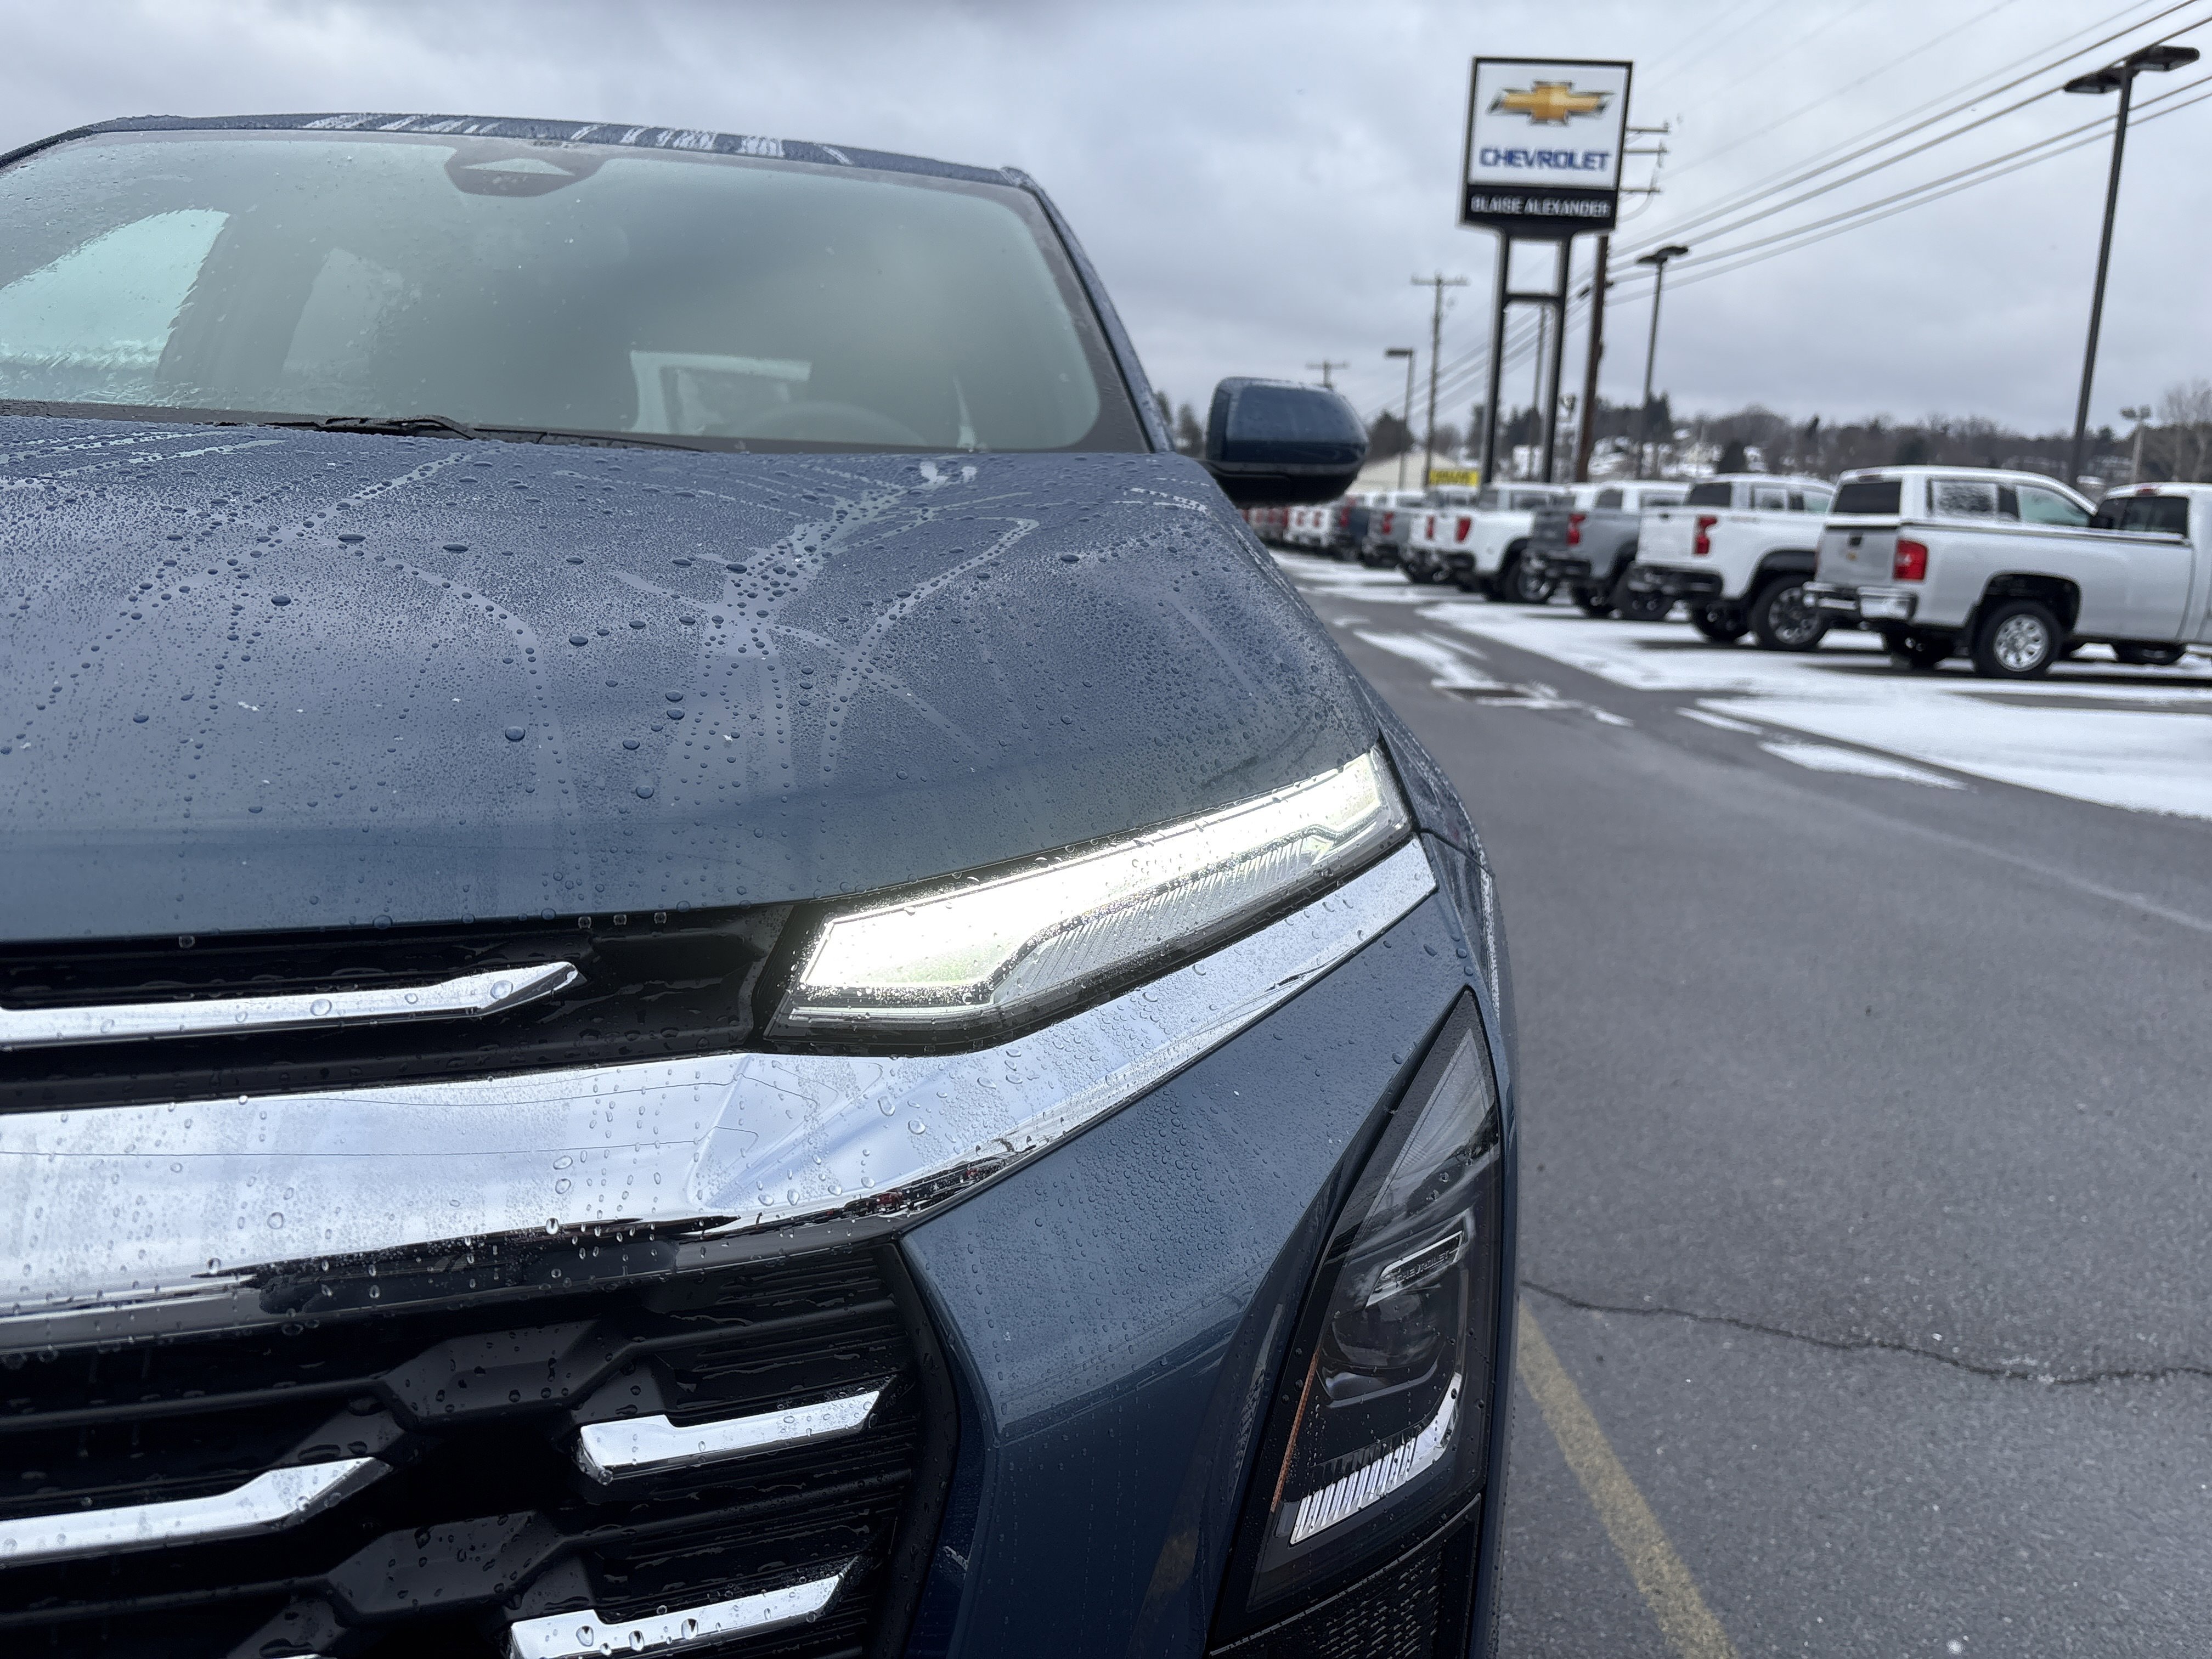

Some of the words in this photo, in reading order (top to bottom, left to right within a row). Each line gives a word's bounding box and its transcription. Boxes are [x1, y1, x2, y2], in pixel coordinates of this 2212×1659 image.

[1480, 148, 1611, 170] CHEVROLET
[1470, 194, 1523, 215] BLAISE
[1524, 197, 1611, 218] ALEXANDER
[1396, 1249, 1449, 1283] CHEVROLET
